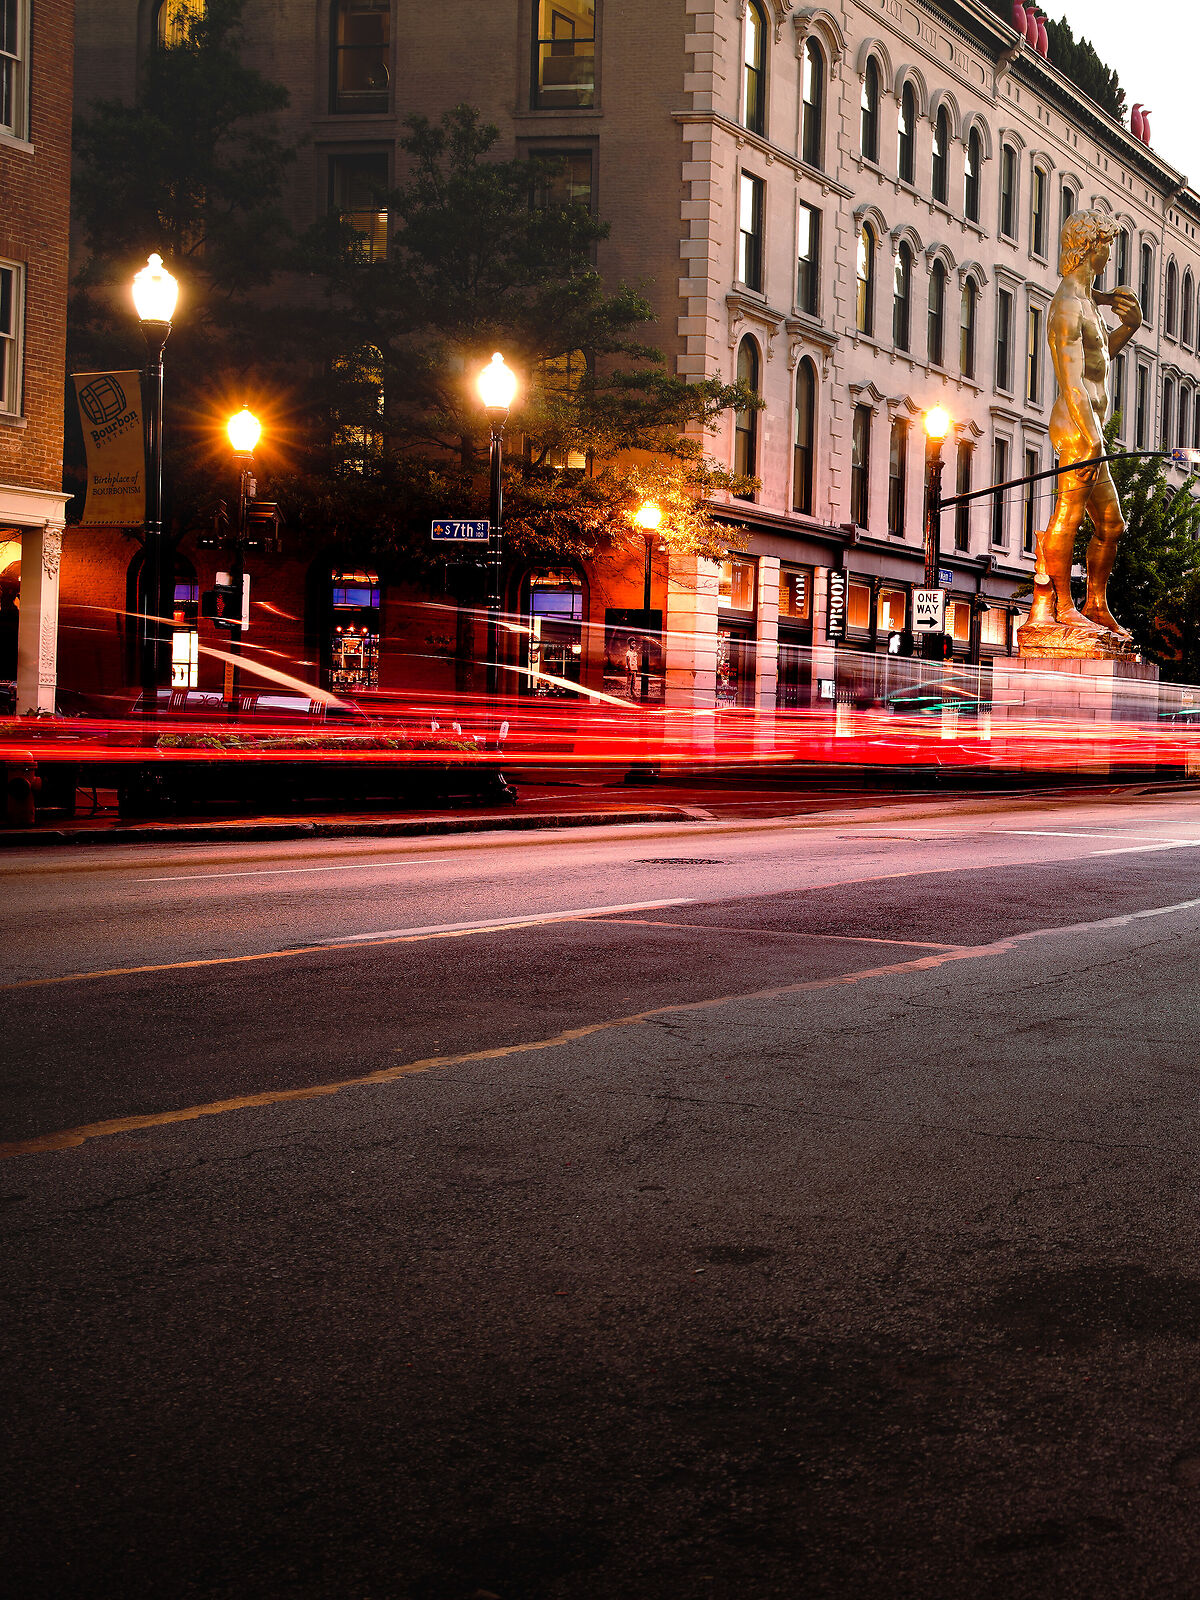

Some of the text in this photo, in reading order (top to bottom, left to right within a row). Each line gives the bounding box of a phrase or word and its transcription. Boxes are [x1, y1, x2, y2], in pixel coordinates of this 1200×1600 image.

[90, 410, 138, 442] Bourbon
[96, 418, 140, 449] DISTRICT
[94, 472, 130, 487] Birthplace
[92, 486, 141, 496] BOURBONISM
[445, 523, 484, 537] S 7th St
[829, 572, 844, 631] PROOF
[917, 593, 939, 603] ONE
[916, 604, 939, 615] WAY
